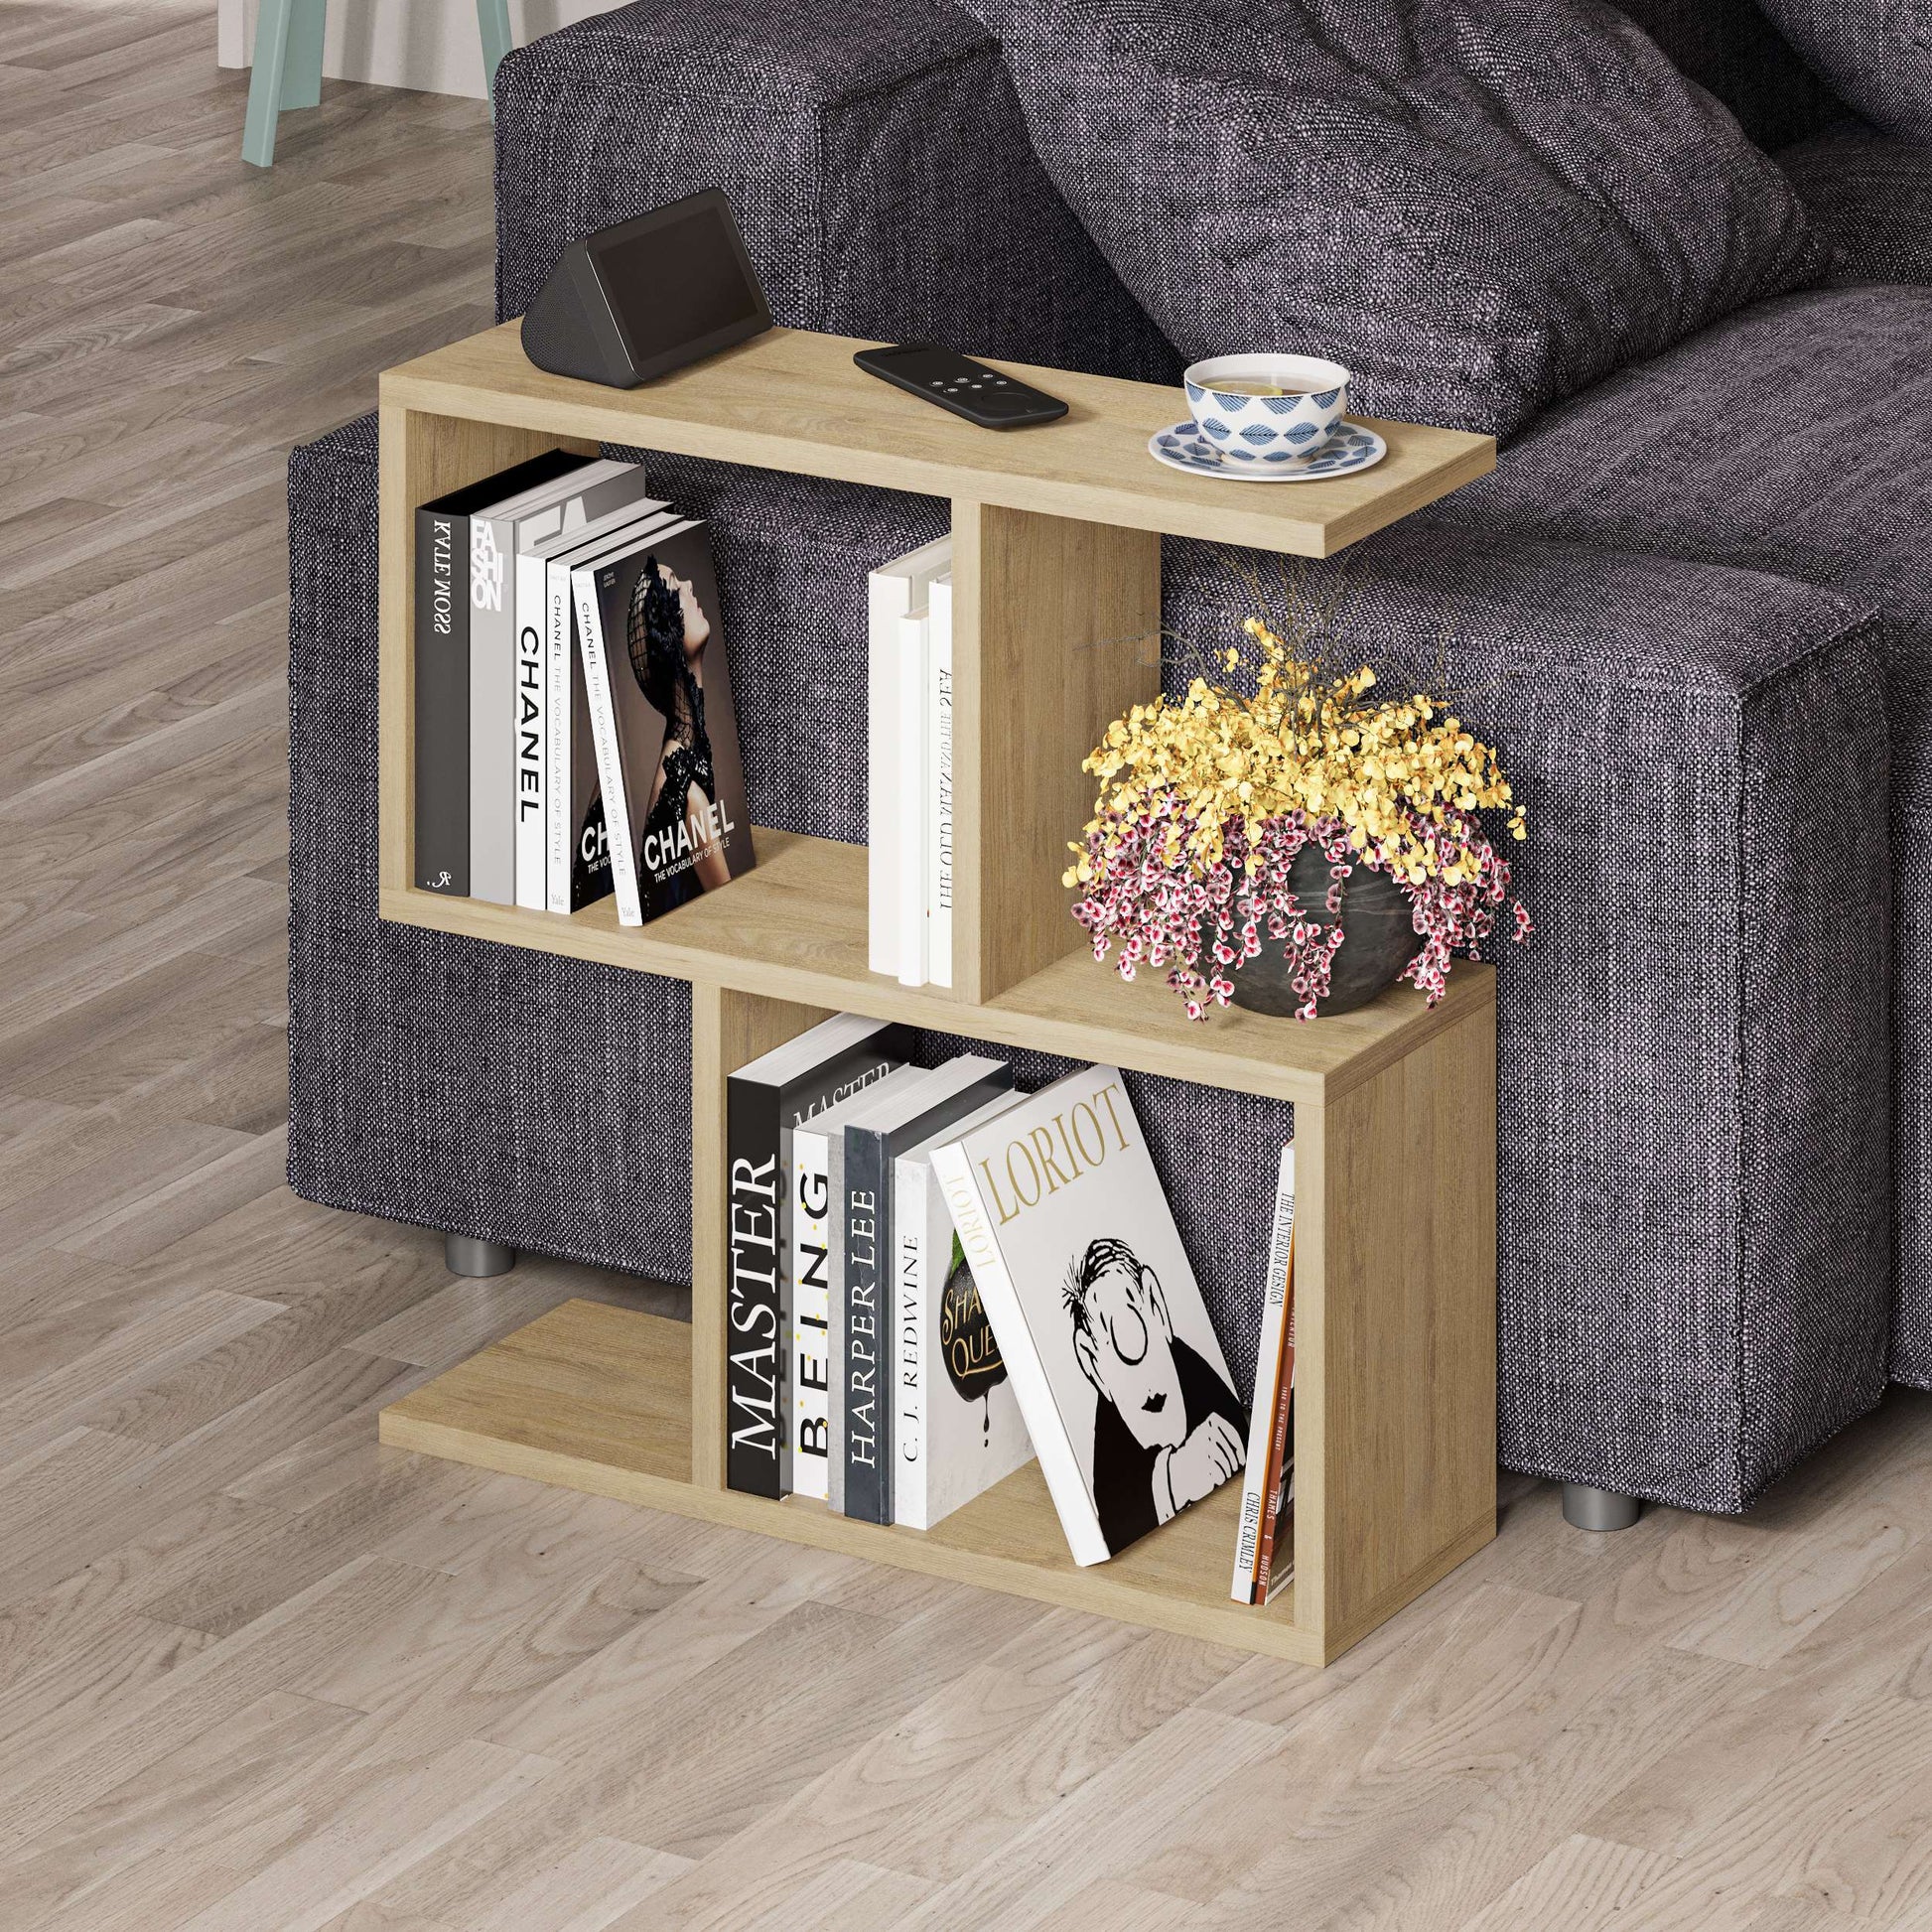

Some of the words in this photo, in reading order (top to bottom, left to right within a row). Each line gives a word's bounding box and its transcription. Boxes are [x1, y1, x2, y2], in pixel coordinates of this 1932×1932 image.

[553, 595, 562, 660] CHANEL
[582, 602, 597, 670] CHANEL
[520, 625, 540, 823] CHANEL
[597, 706, 616, 804] VOCABULARY
[554, 798, 562, 817] OF
[611, 808, 620, 828] OF
[614, 831, 626, 877] STYLE
[644, 799, 735, 872] CHANEL
[654, 869, 666, 884] THE
[666, 848, 704, 878] VOCABULARY
[704, 845, 713, 858] OF
[713, 837, 730, 856] STYLE
[588, 861, 599, 875] THE
[551, 894, 565, 907] Yale
[621, 906, 635, 918] Yale
[978, 1082, 1130, 1226] LORIOT
[945, 1176, 997, 1268] LORIOT
[1280, 1192, 1295, 1215] THE
[851, 1190, 876, 1270] LEE
[1274, 1215, 1293, 1266] INTERIOR
[730, 1153, 777, 1460] MASTER
[799, 1173, 828, 1458] BEING
[902, 1235, 918, 1390] REDWINE
[851, 1282, 876, 1468] HARPER
[951, 1323, 1003, 1381] QUE
[903, 1405, 919, 1424] J.
[902, 1437, 918, 1462] C.
[1243, 1491, 1261, 1526] CHRIS
[1266, 1489, 1278, 1521] THAMES
[1259, 1554, 1270, 1587] HUDSON
